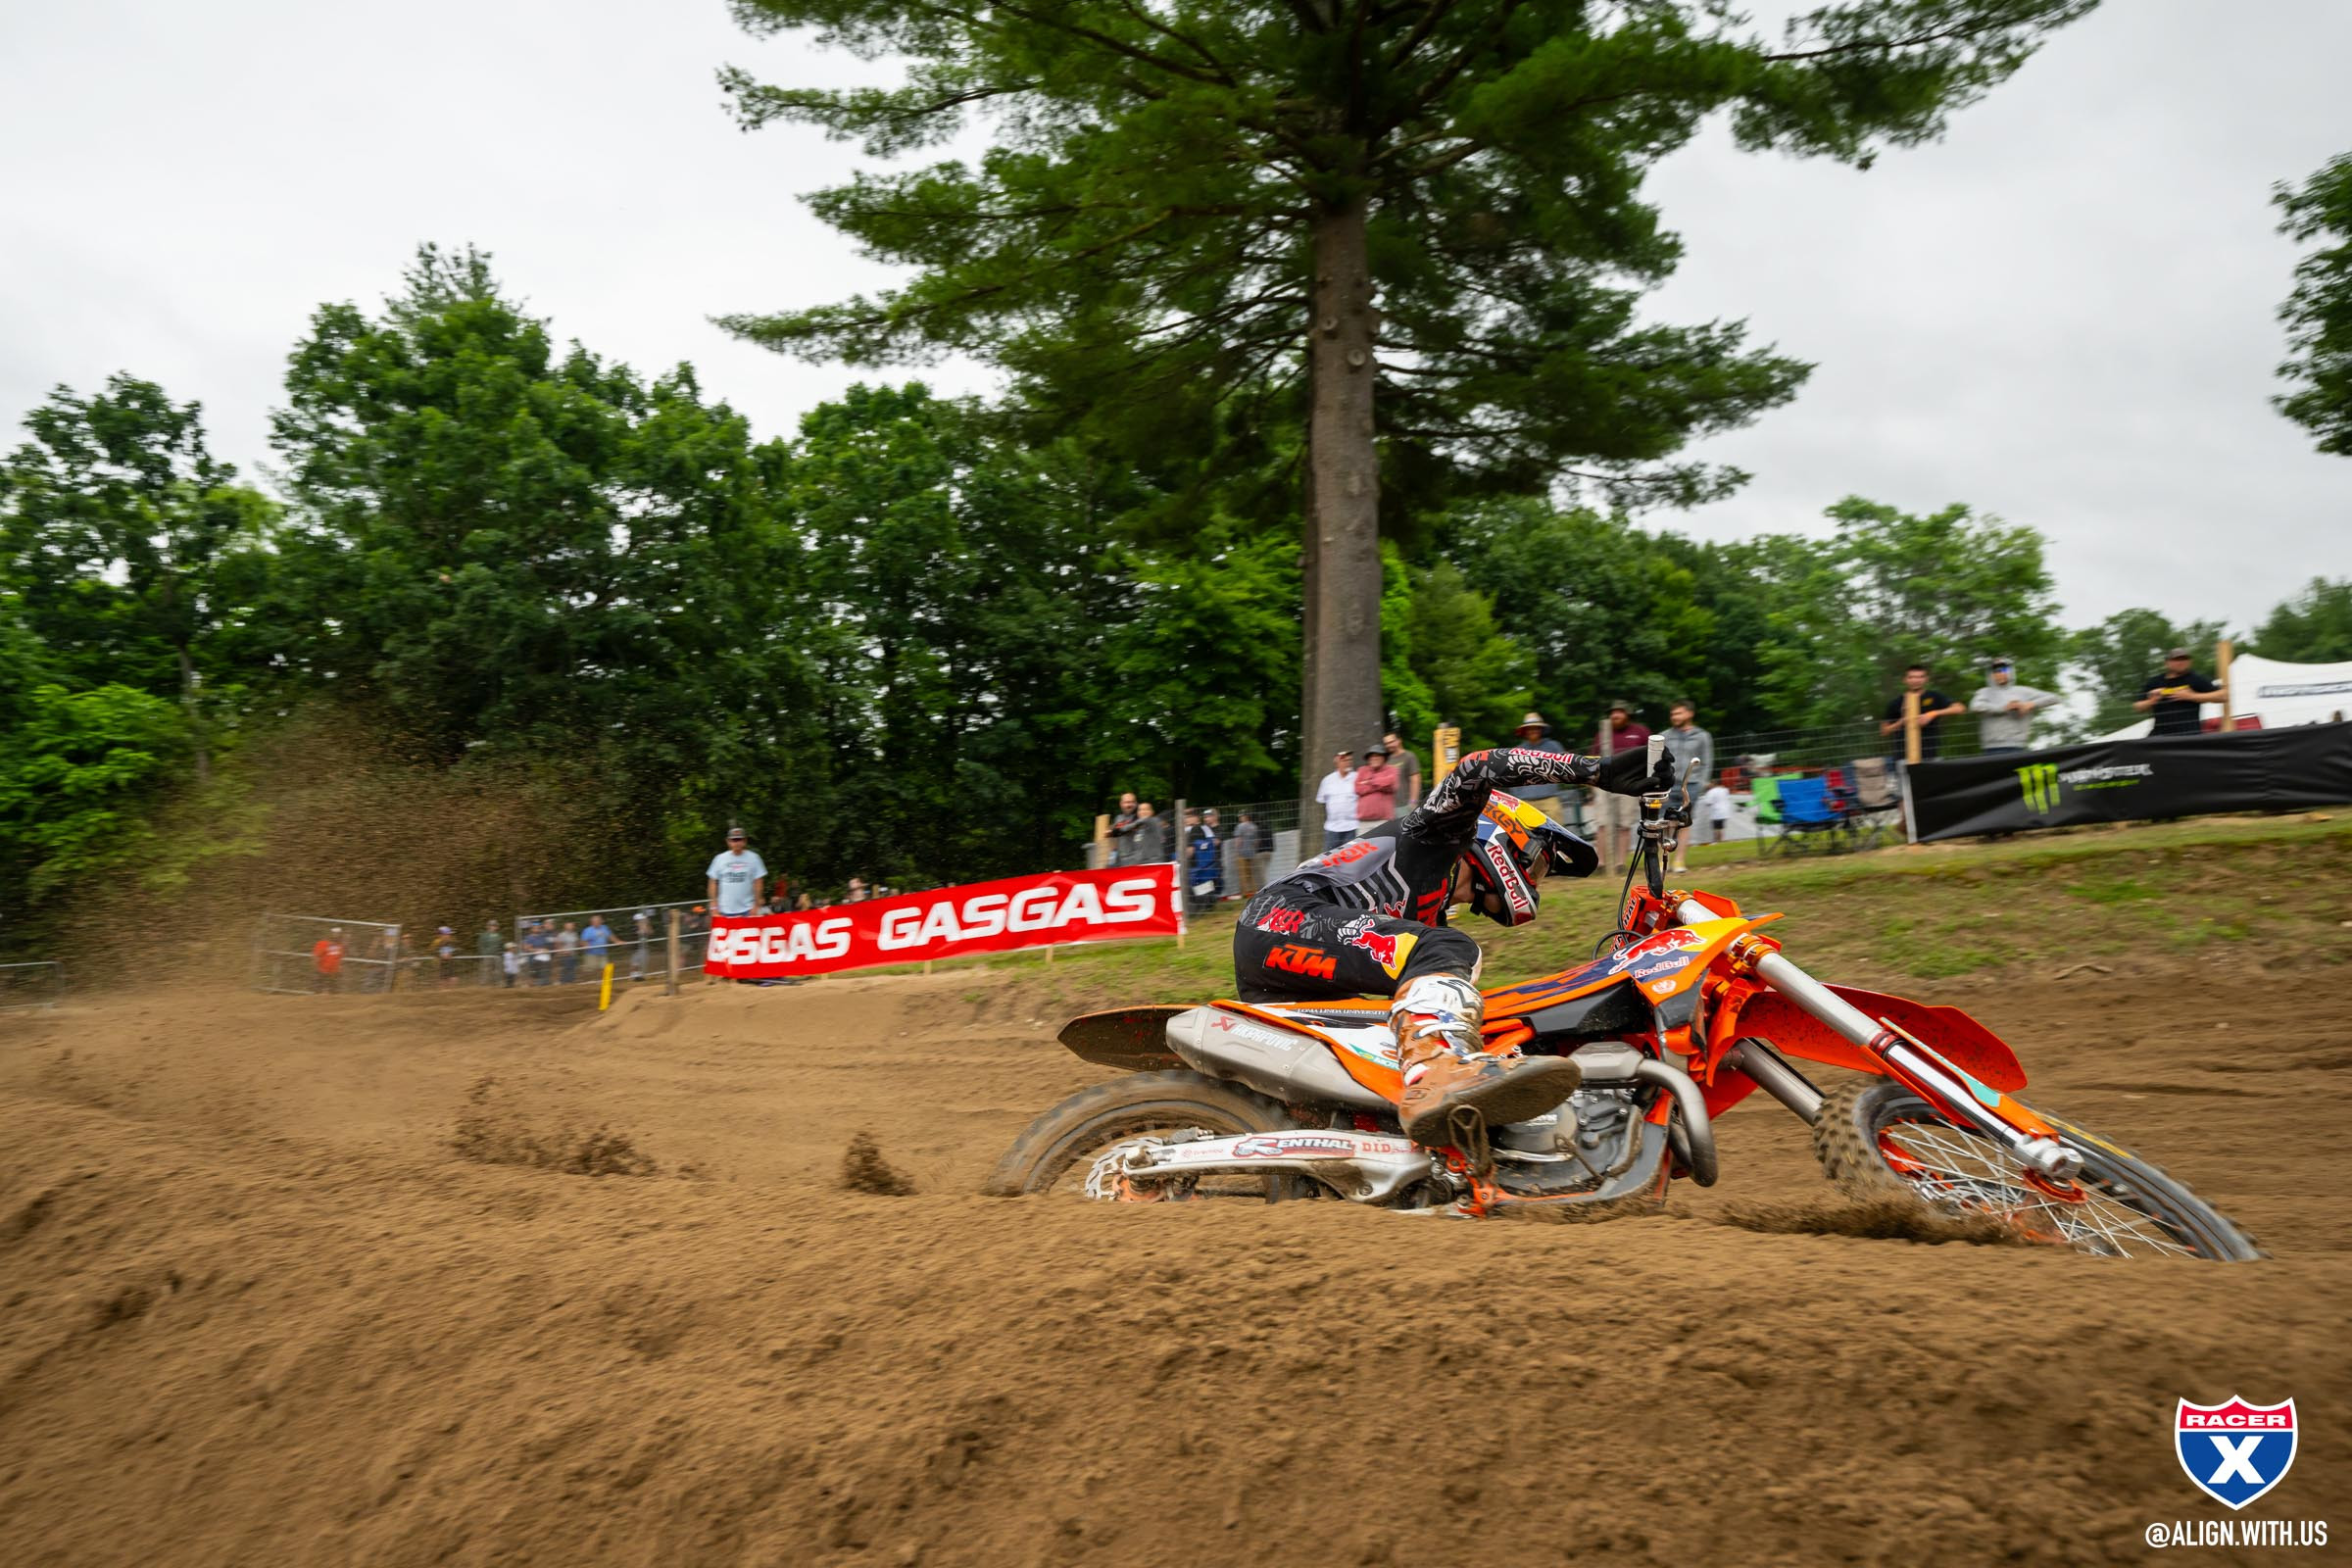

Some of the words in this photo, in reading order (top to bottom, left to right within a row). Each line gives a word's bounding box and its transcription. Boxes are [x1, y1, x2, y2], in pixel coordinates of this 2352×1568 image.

[1485, 803, 1523, 835] AKLEY
[1488, 844, 1515, 878] Red
[1504, 875, 1530, 911] Bull
[877, 878, 1157, 952] GASGAS
[1265, 944, 1338, 980] KTM
[1635, 960, 1664, 979] Red
[1662, 956, 1690, 972] Bull
[1235, 1137, 1354, 1157] RENTHAL
